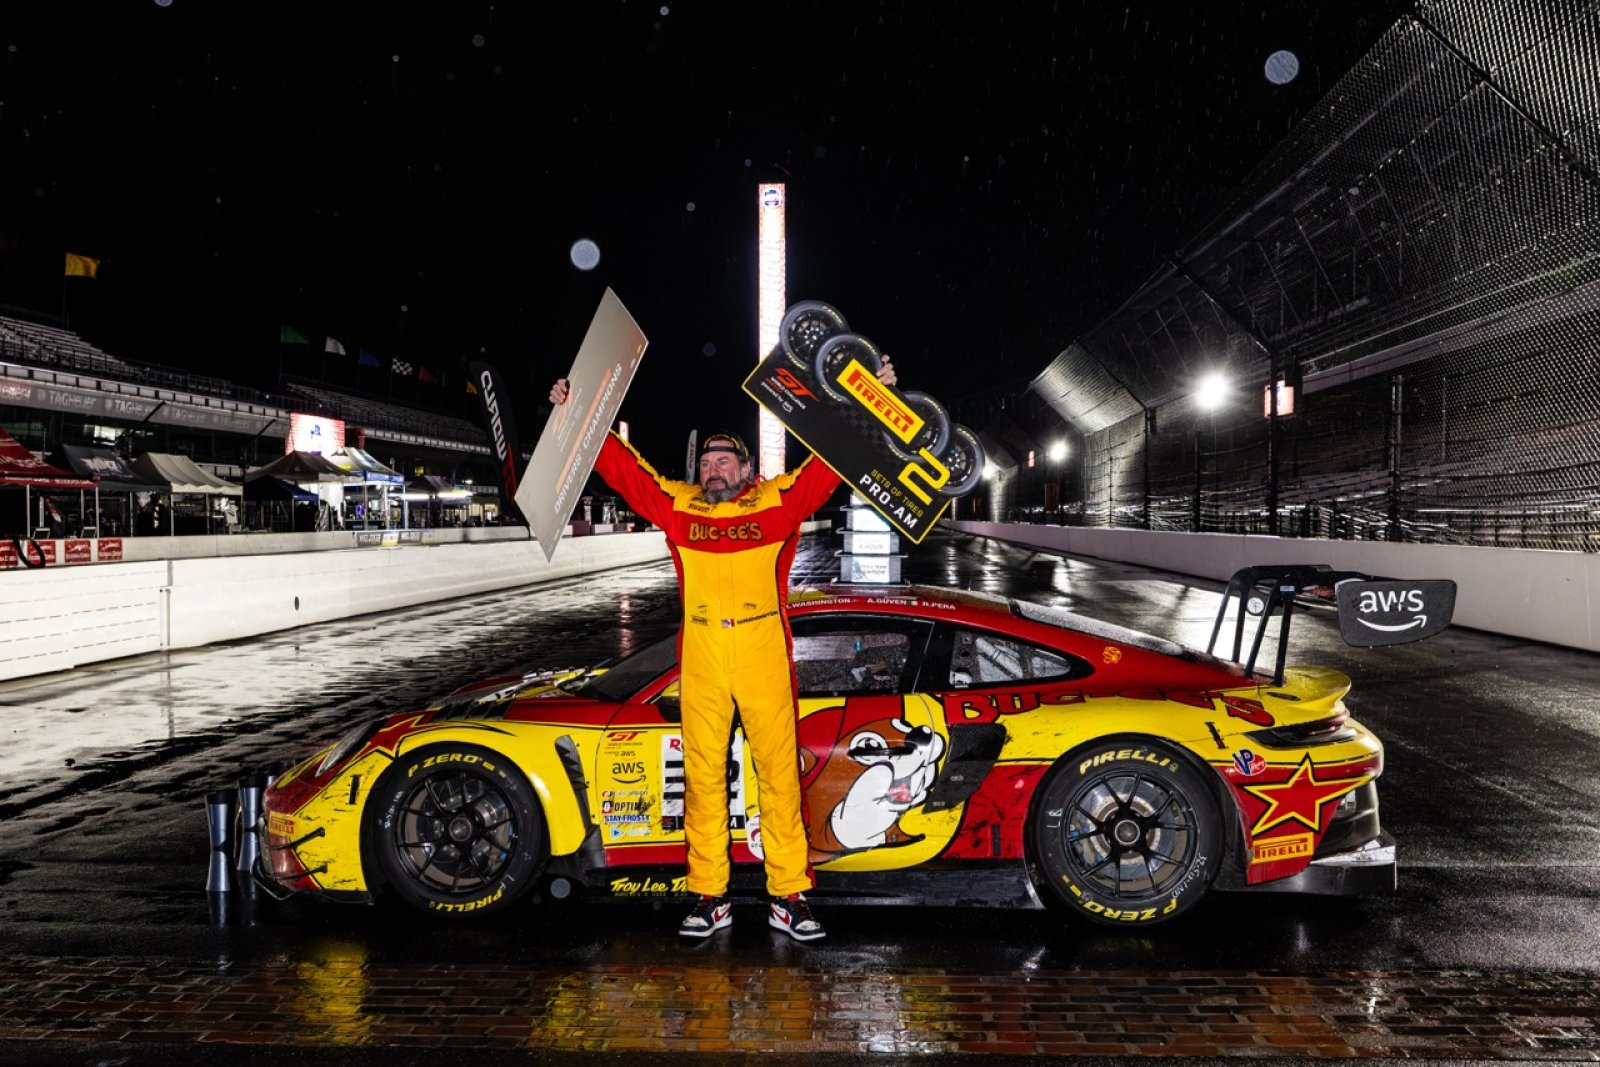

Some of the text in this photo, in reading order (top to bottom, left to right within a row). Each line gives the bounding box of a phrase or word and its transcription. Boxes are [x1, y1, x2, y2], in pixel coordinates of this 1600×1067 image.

[582, 362, 622, 450] CHAMPIONS
[847, 369, 916, 434] PIRELLI
[897, 447, 951, 505] 2
[859, 474, 918, 529] PRO-AM
[871, 469, 923, 518] SETS OF TIRES
[922, 601, 956, 610] R.PERA
[1359, 589, 1425, 613] aws
[422, 752, 478, 768] ZERO
[612, 762, 645, 774] aws
[1079, 748, 1171, 775] PIRELLI
[1232, 749, 1255, 775] VP
[1254, 837, 1309, 859] PIRELLI
[610, 877, 642, 894] Troy
[641, 877, 669, 892] Lee
[435, 889, 504, 912] PIRELLI
[1083, 900, 1158, 921] ZERO
